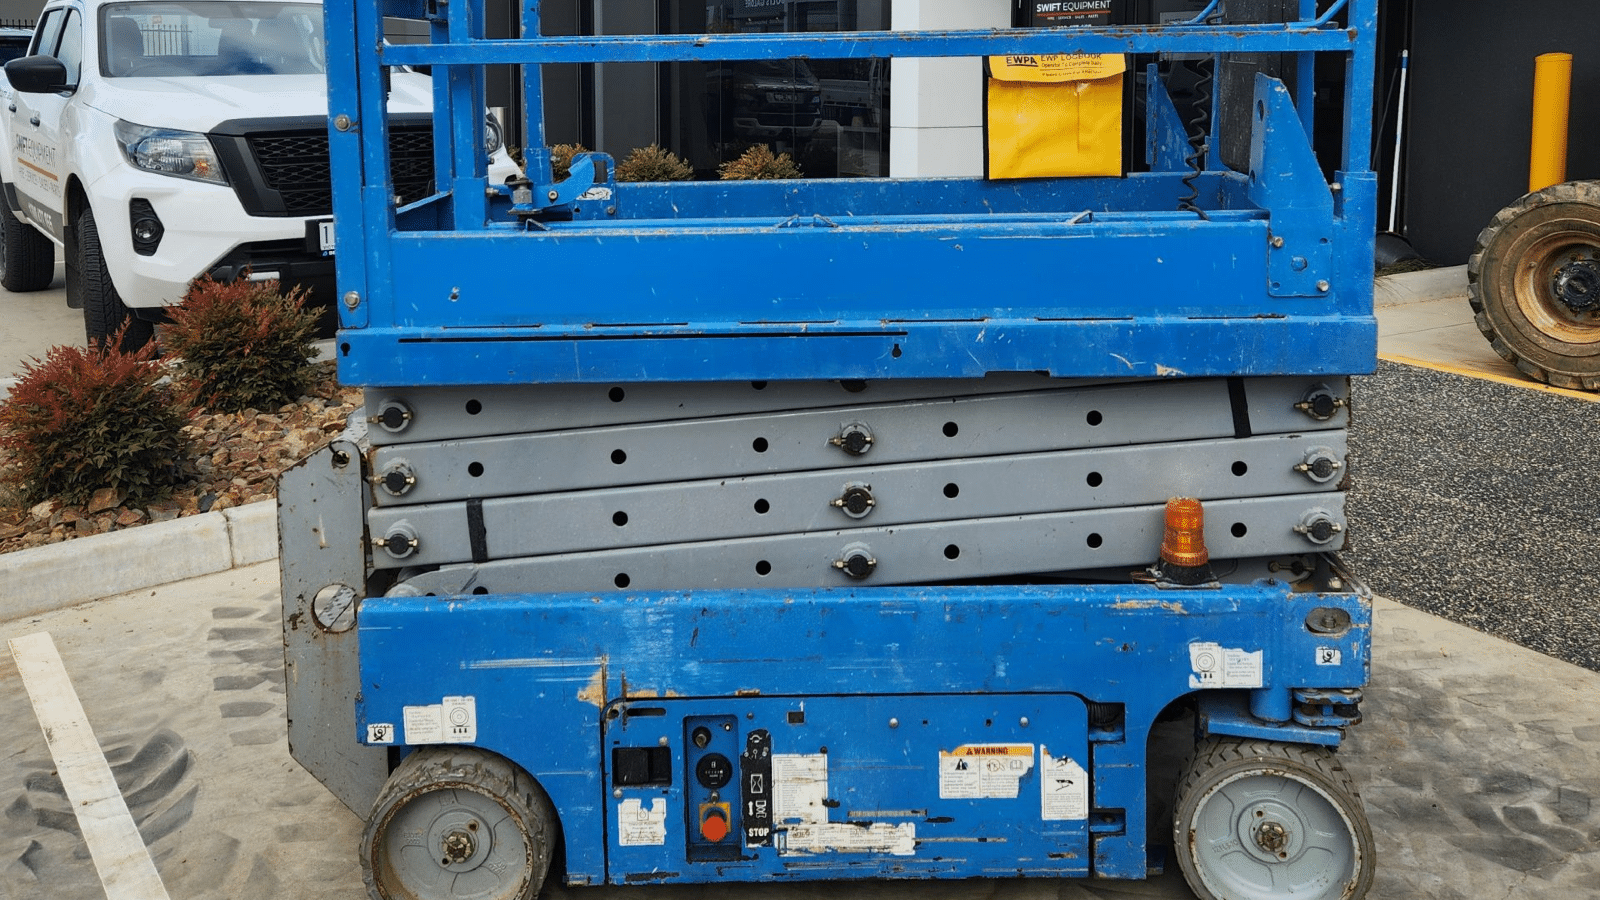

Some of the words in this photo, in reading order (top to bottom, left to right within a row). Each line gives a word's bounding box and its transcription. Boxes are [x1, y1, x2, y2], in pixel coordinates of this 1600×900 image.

[1036, 3, 1061, 12] SWIFT
[1062, 0, 1112, 12] EQUIPMENT
[1006, 56, 1038, 65] EWPA
[973, 747, 1009, 755] WARNING
[748, 828, 769, 837] STOP
